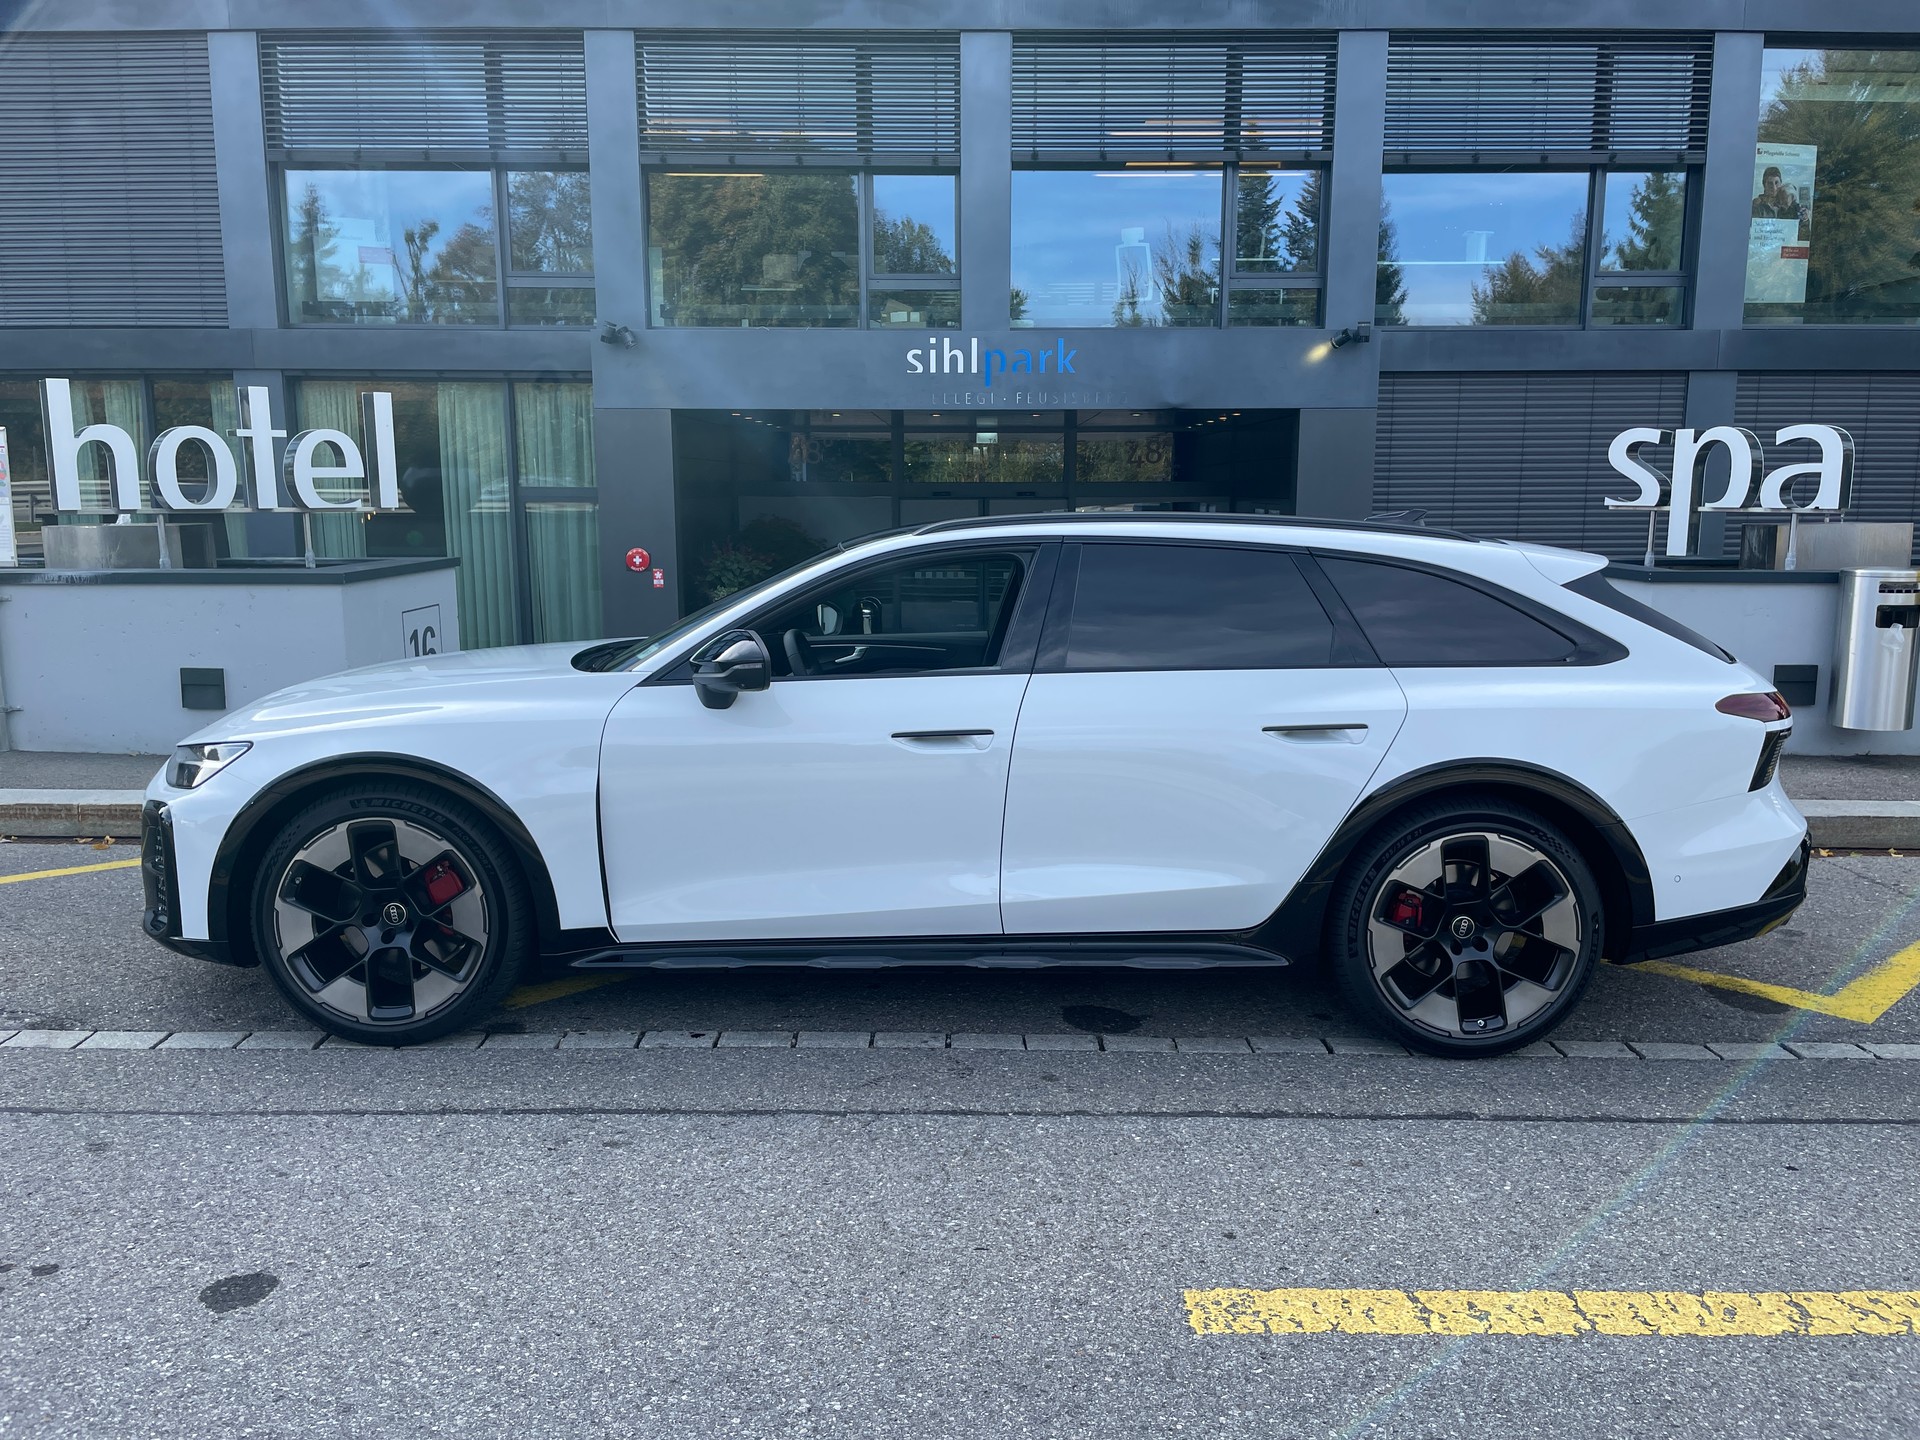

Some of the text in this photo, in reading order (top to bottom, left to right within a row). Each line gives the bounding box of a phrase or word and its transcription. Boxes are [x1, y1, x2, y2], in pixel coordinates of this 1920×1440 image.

[906, 337, 1077, 388] sihlpark
[41, 377, 399, 511] hotel
[1604, 424, 1855, 556] spa
[370, 799, 447, 823] MICHELIN
[1349, 867, 1377, 940] MICHELIN
